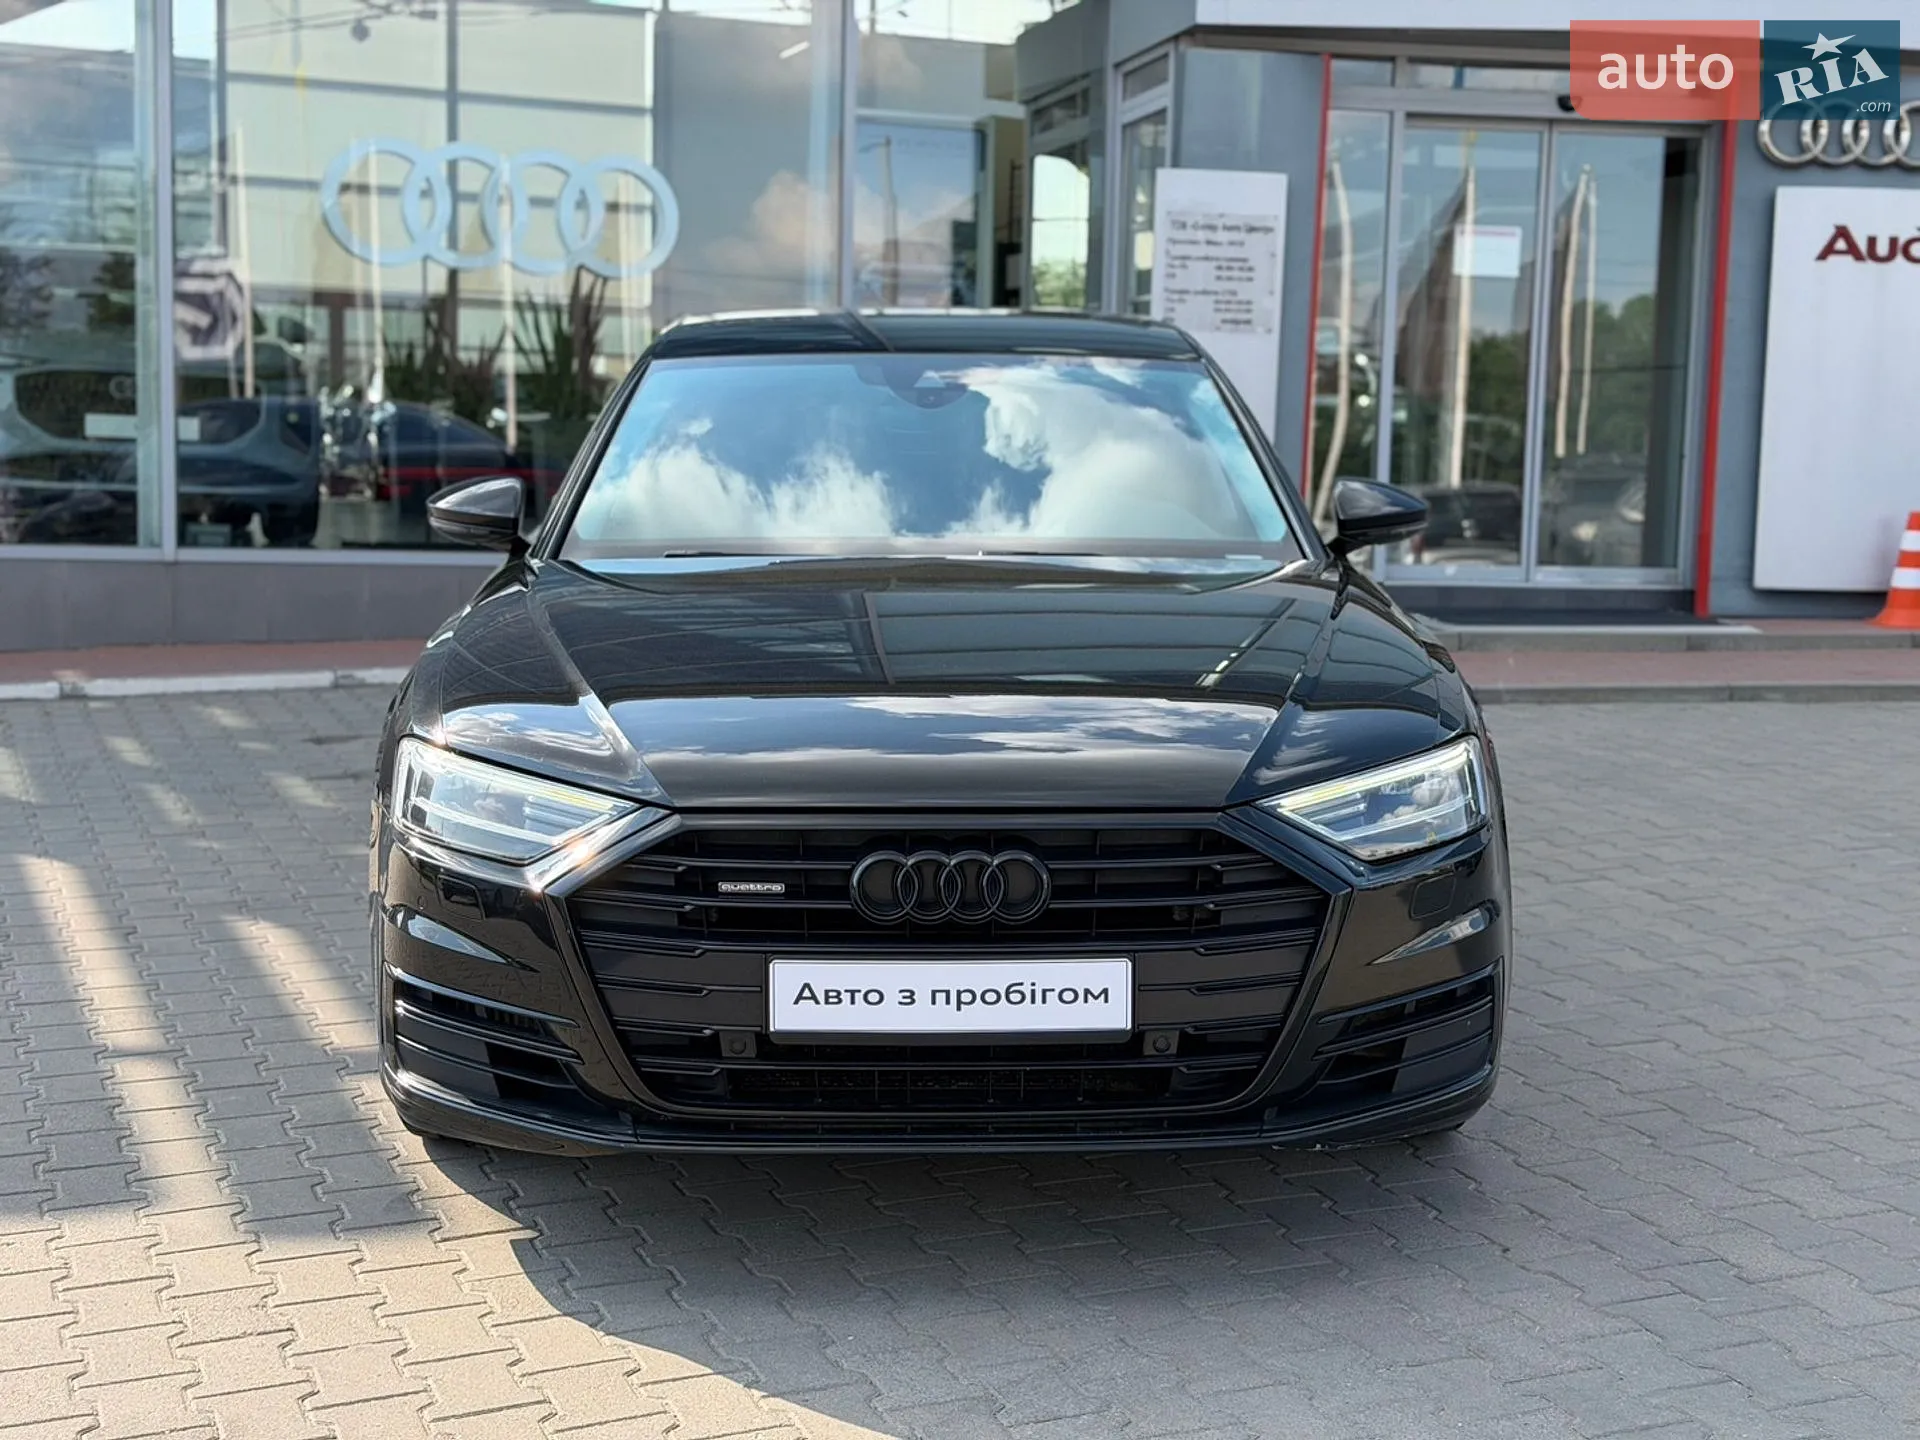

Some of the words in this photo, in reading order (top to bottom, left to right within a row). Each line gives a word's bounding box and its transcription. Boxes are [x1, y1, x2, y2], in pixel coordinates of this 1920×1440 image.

[720, 883, 783, 893] quattro
[793, 982, 885, 1006] Авто
[898, 987, 917, 1006] з
[930, 981, 1110, 1012] пробігом
